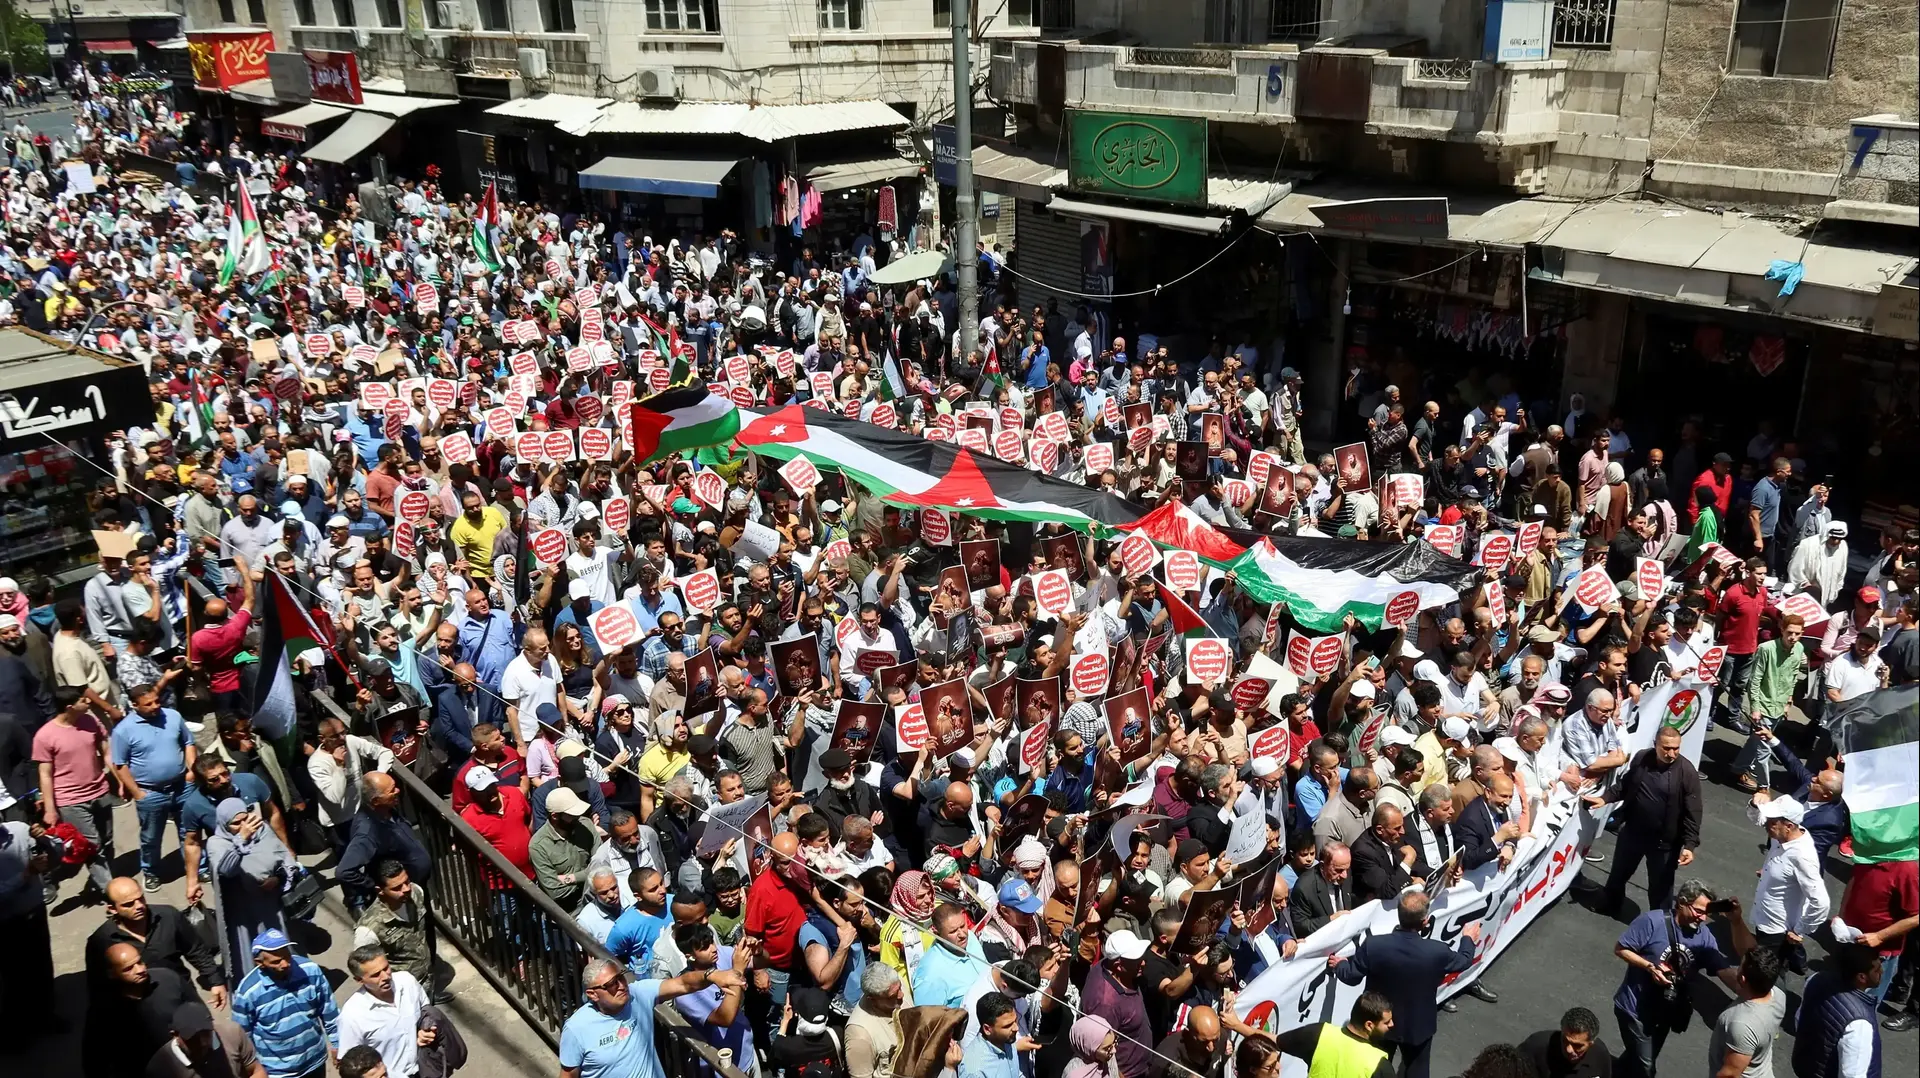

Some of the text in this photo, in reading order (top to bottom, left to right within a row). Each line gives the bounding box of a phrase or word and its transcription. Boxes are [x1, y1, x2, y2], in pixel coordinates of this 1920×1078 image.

[1267, 66, 1282, 97] 5
[1853, 127, 1882, 169] 7
[599, 1035, 614, 1047] AERO
